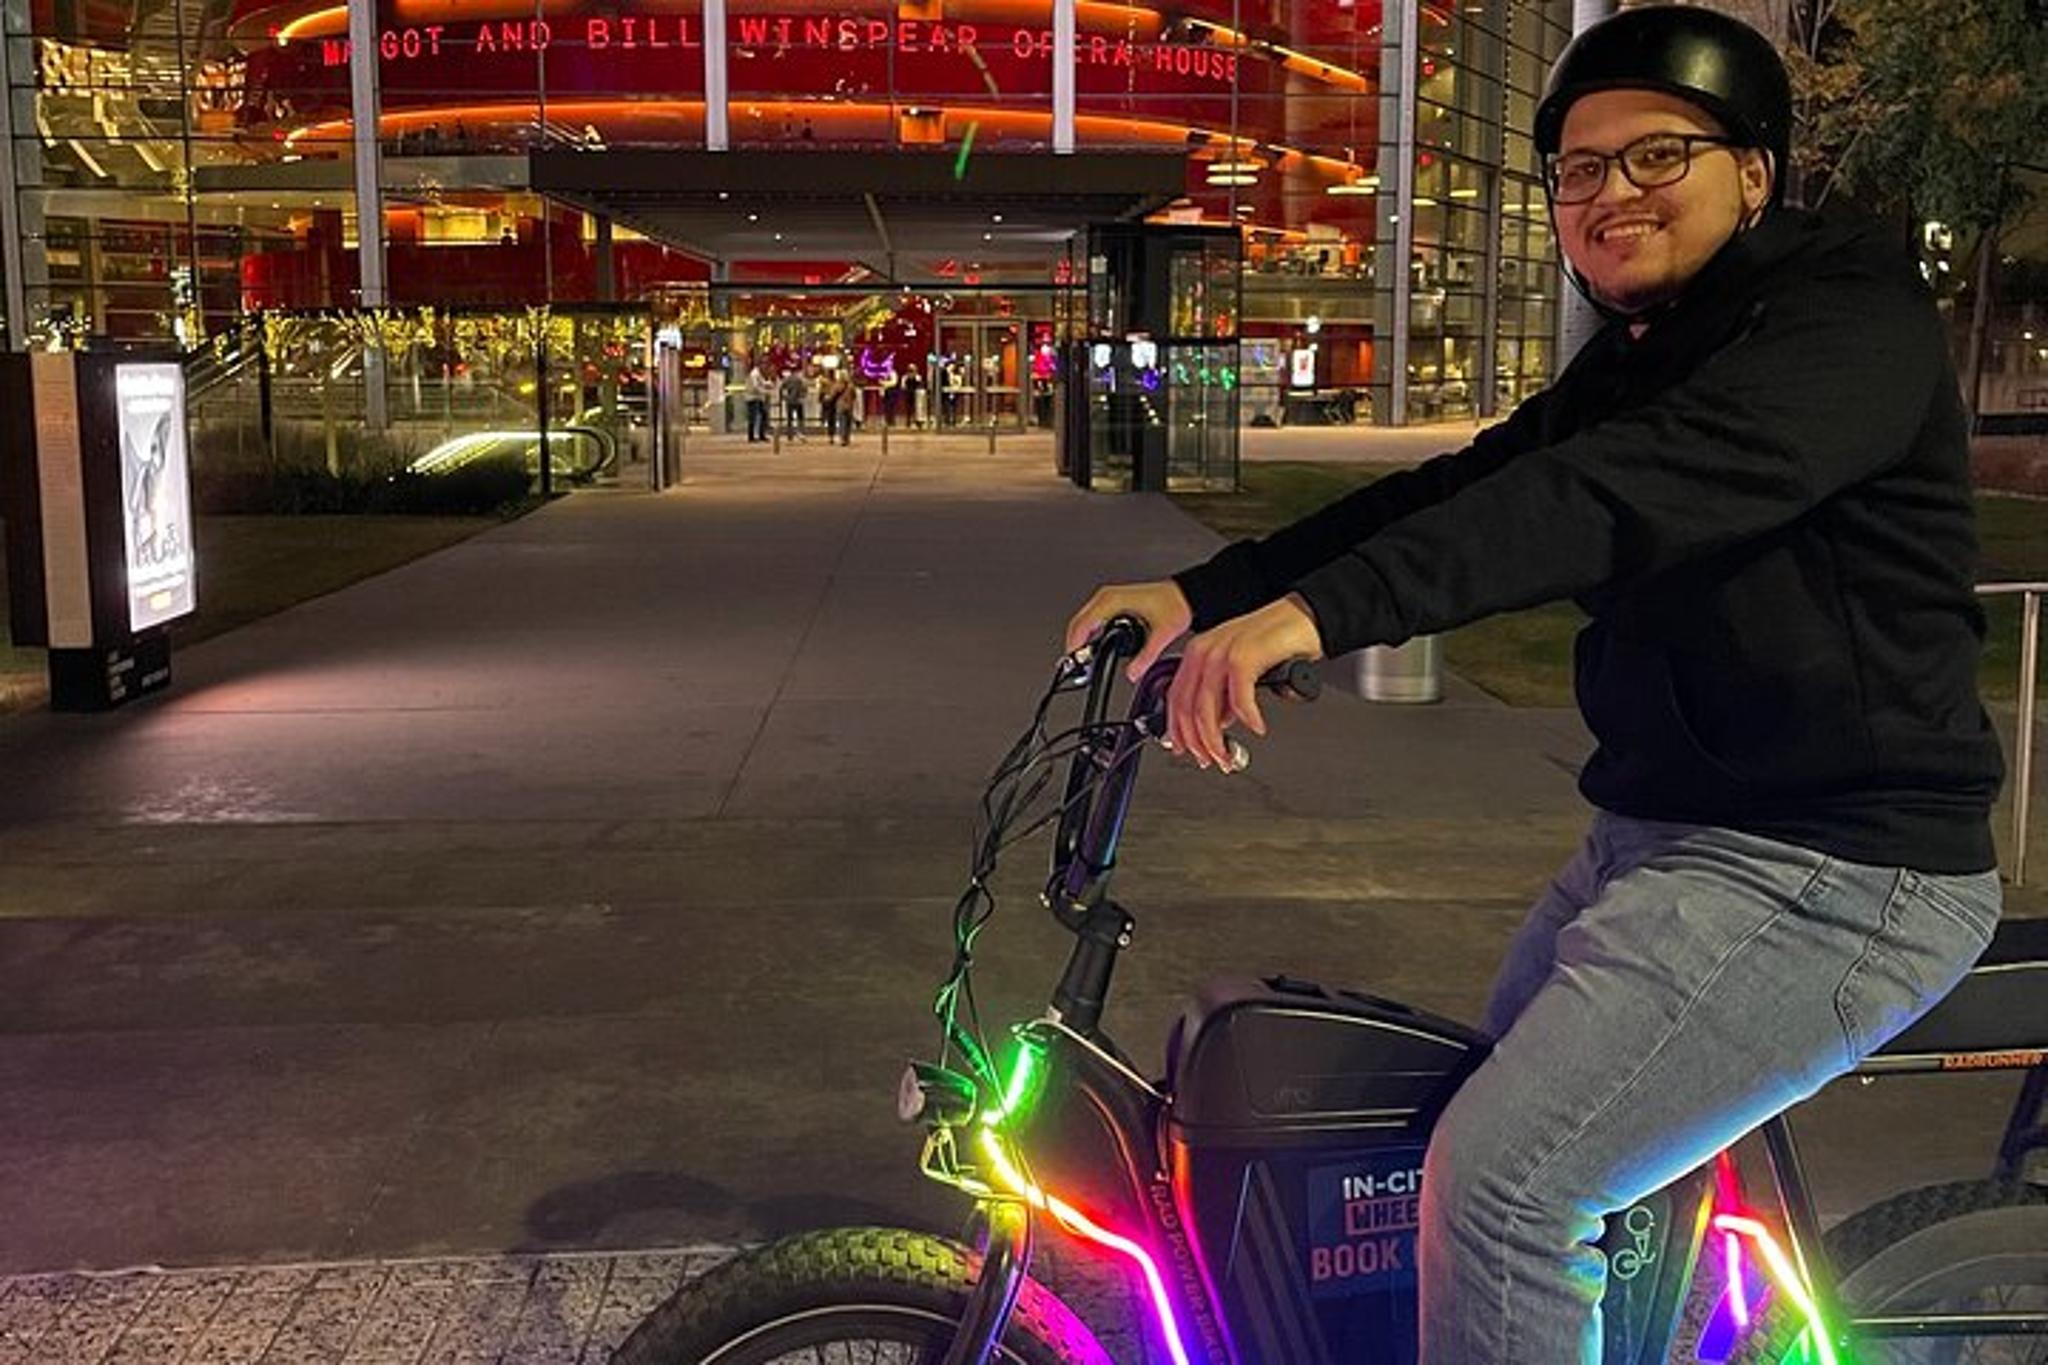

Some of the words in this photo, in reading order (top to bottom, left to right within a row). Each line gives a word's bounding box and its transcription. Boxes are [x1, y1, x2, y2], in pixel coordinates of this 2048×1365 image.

[323, 26, 444, 66] MAGOT
[476, 22, 550, 53] AND
[588, 19, 701, 49] BILL
[740, 18, 977, 54] WINSPEAR
[1156, 45, 1237, 83] HOUSE
[1311, 1238, 1402, 1281] BOOK
